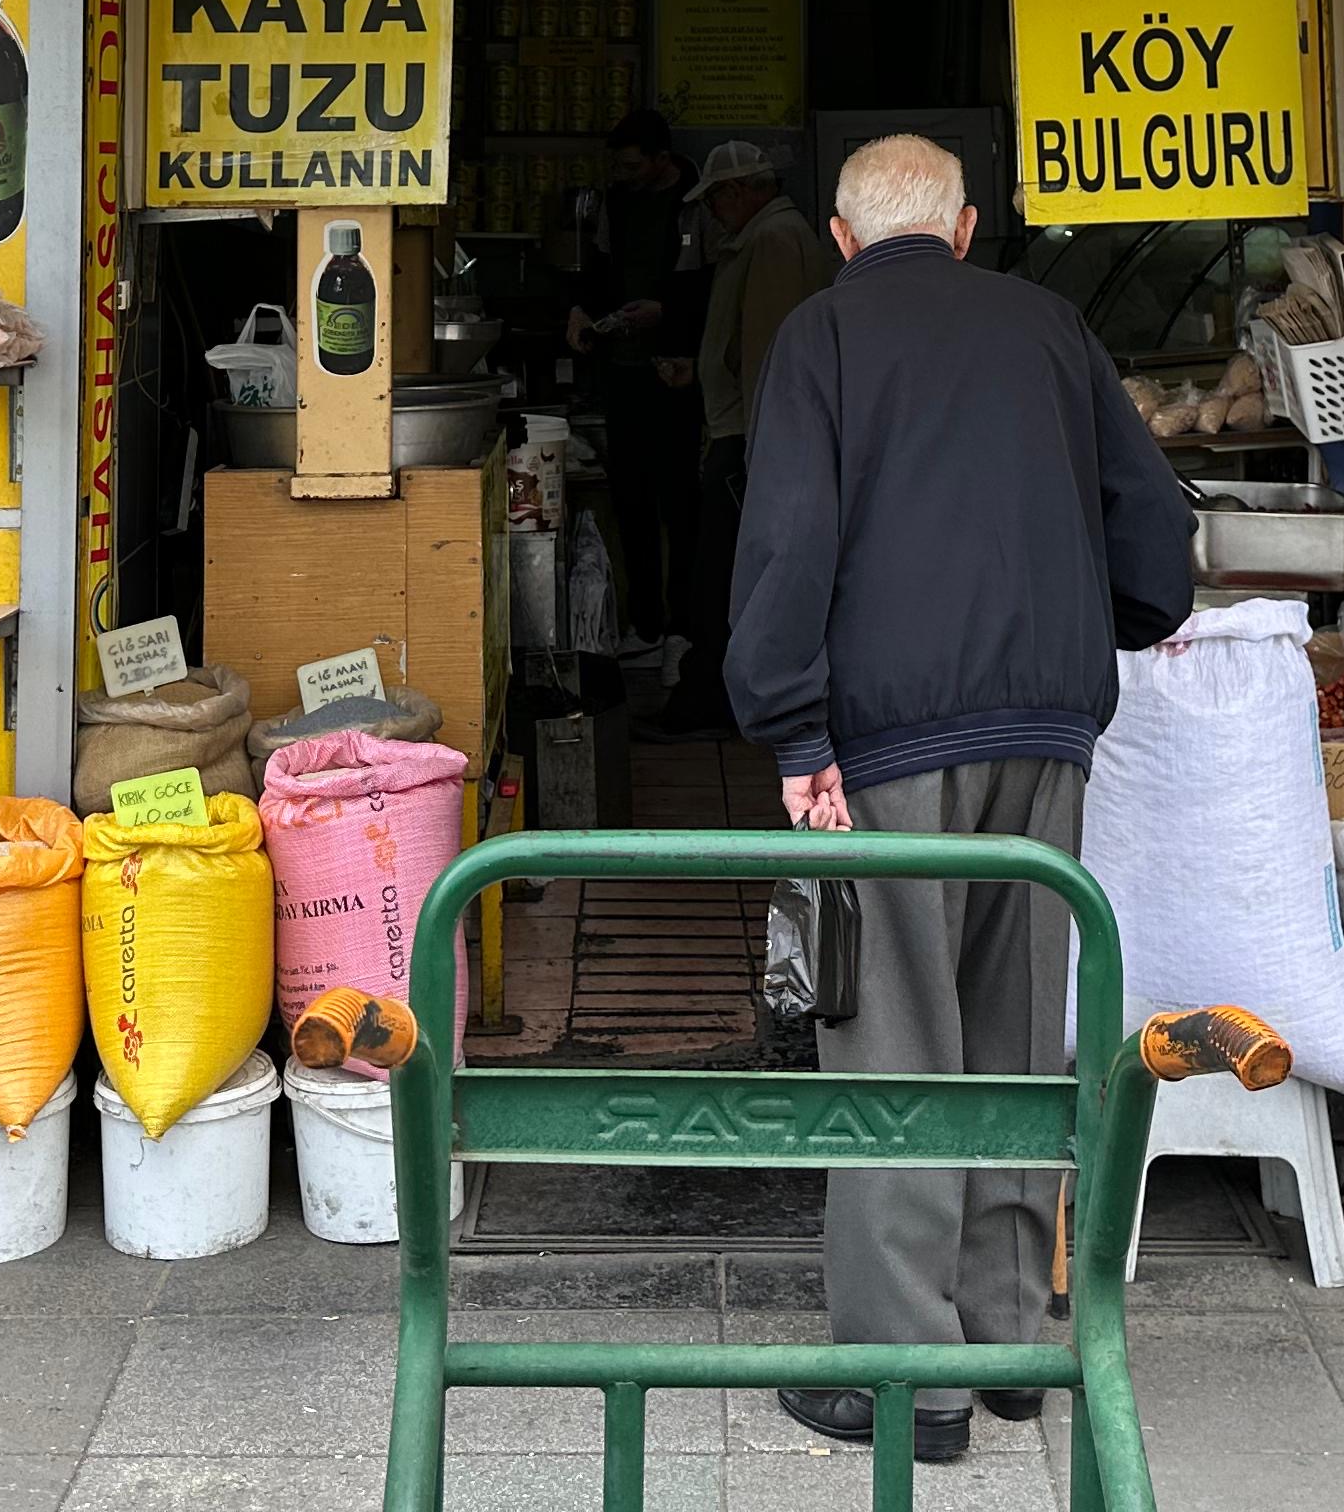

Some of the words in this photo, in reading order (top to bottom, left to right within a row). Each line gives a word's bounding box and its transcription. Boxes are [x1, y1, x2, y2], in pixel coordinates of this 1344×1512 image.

[1080, 12, 1234, 94] KÖY
[162, 62, 426, 134] TUZU
[158, 149, 433, 189] KULLANIN
[1035, 110, 1294, 194] BULGURU
[138, 630, 170, 650] SARI
[301, 893, 366, 919] KIRMA
[380, 884, 406, 981] caretta
[120, 904, 136, 1004] caretta
